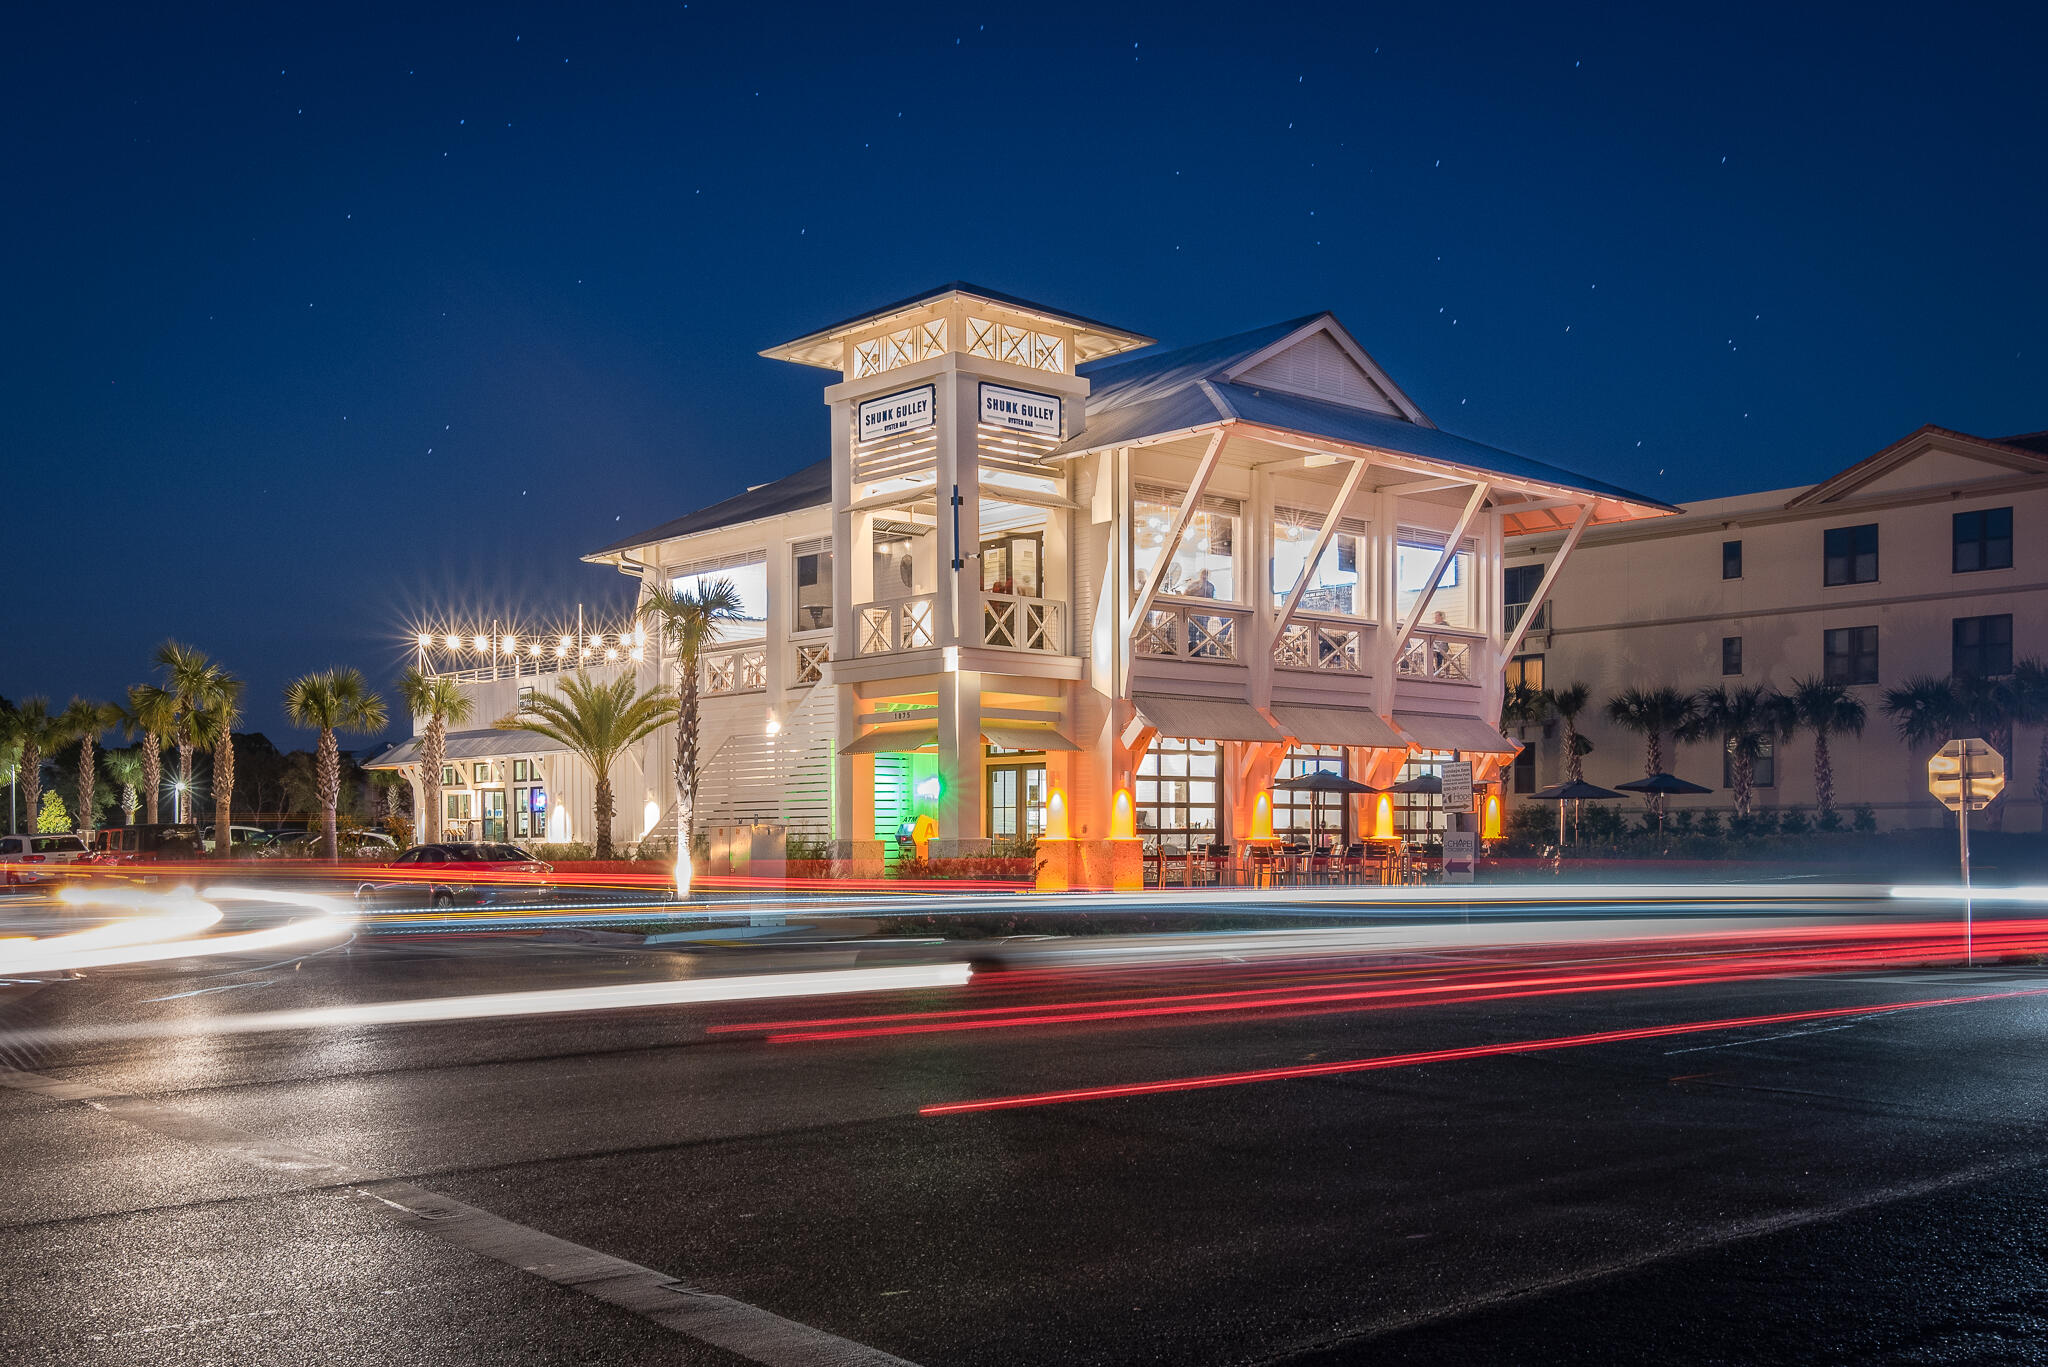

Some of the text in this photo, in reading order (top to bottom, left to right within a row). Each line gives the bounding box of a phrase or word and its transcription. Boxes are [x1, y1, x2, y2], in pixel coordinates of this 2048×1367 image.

[865, 400, 927, 426] SHUNK GULLEY
[986, 397, 1054, 421] SHUNK GULLEY
[884, 420, 907, 431] OYSTER BAR
[1008, 417, 1024, 426] OYSTER
